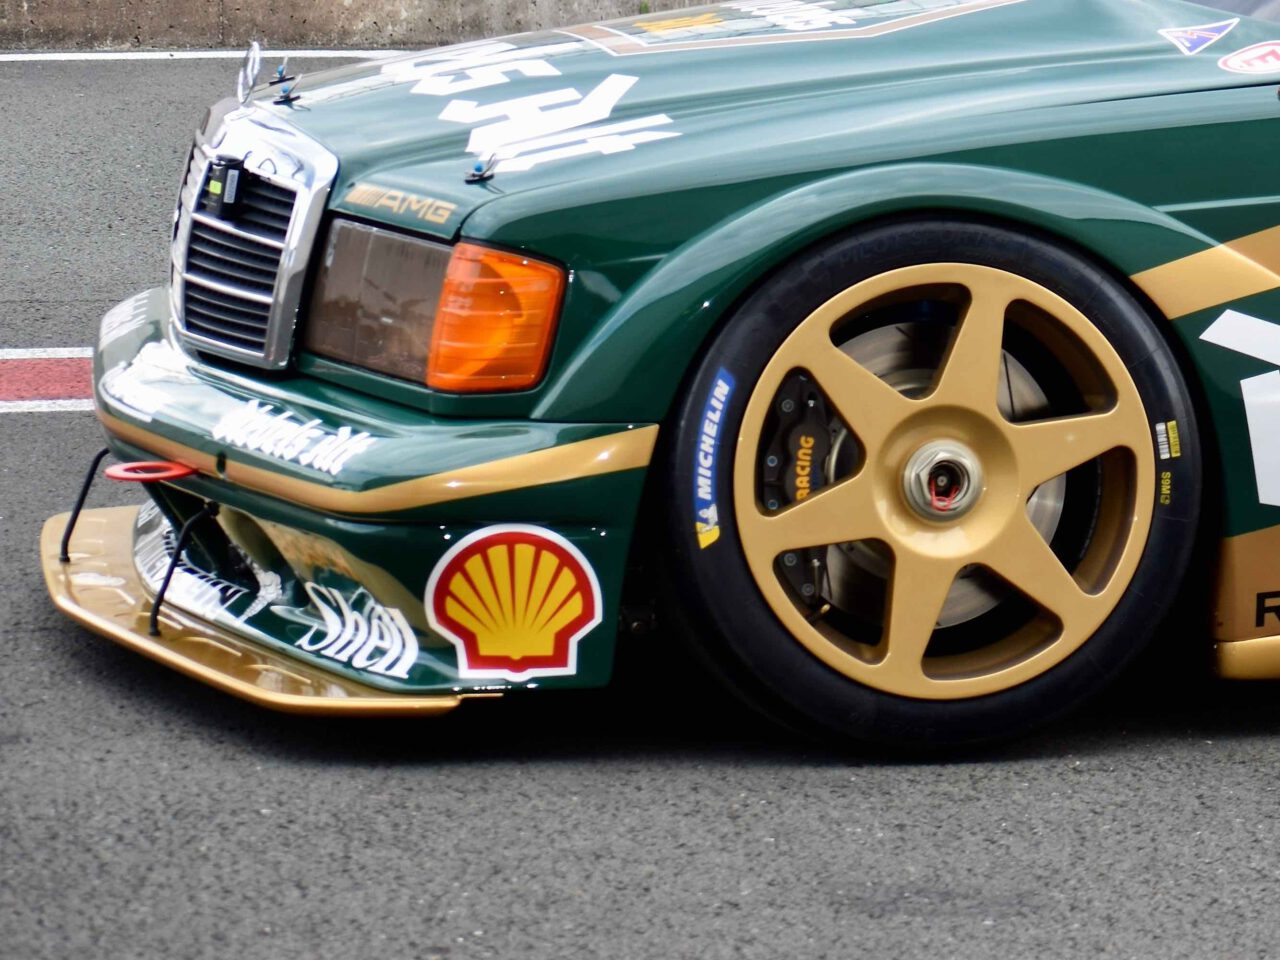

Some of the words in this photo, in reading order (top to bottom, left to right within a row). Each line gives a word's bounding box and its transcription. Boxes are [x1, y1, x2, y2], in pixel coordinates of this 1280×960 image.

[376, 189, 459, 224] AMG
[696, 379, 730, 500] MICHELIN
[293, 581, 419, 680] Shell
